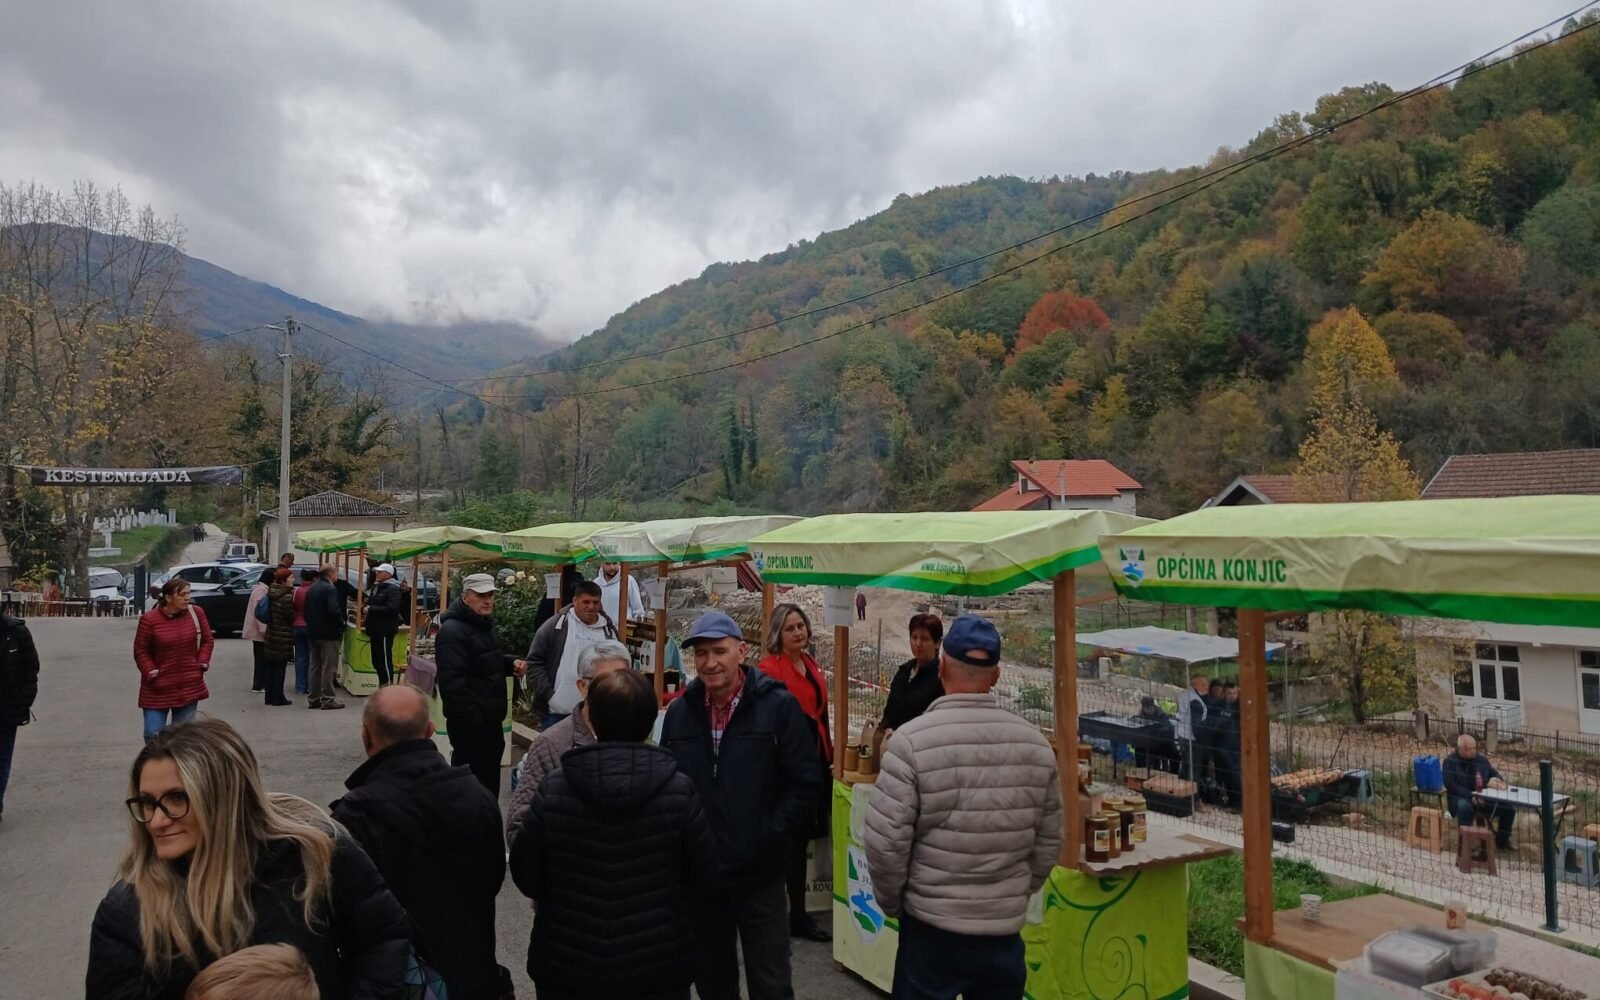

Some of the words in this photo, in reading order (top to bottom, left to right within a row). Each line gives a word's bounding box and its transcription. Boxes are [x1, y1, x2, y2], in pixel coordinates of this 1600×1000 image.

[44, 469, 192, 483] KESTENIJADA
[790, 555, 814, 570] KONJIC
[1157, 553, 1217, 580] OPĆINA
[1223, 558, 1287, 583] KONJIC
